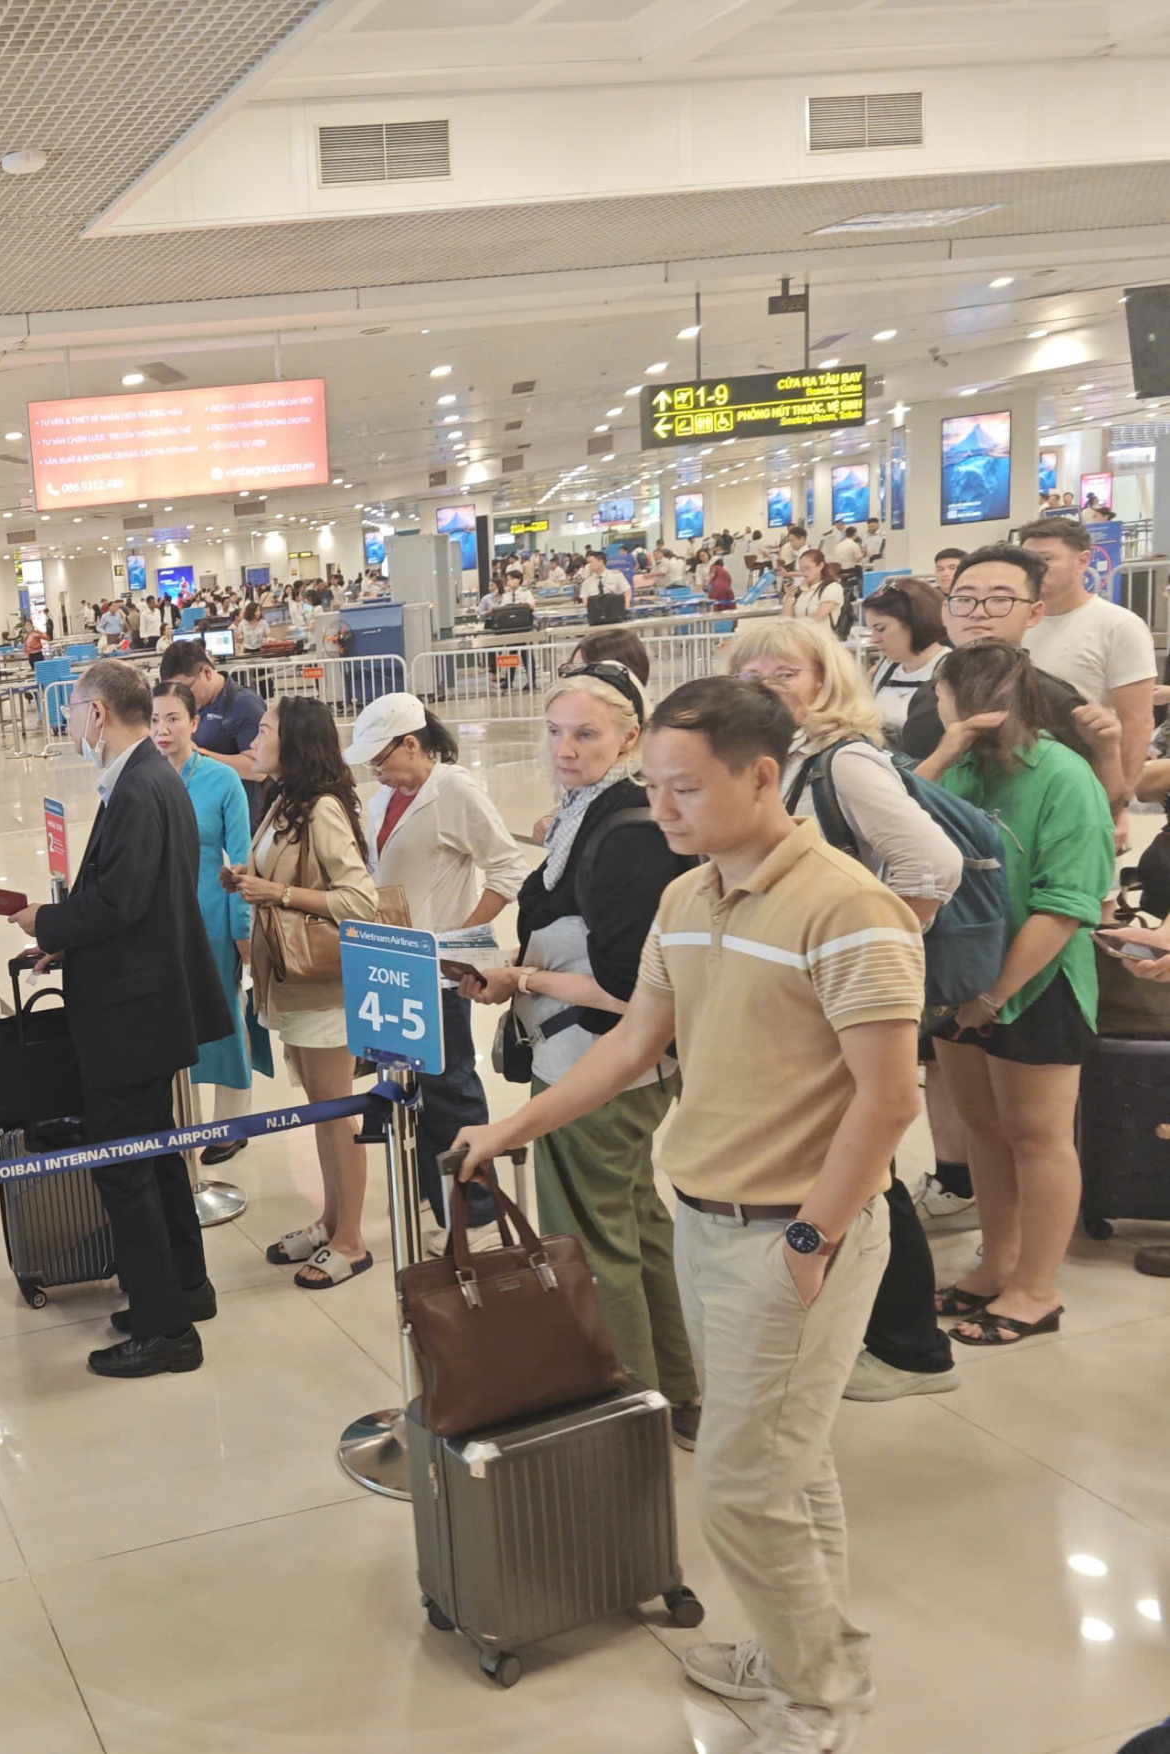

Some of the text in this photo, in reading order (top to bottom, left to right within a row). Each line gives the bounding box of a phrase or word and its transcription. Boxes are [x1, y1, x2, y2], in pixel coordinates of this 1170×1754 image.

[802, 376, 818, 388] RA
[818, 372, 840, 385] TÀU
[841, 372, 862, 384] BAY
[806, 384, 862, 396] Boarding Gates
[696, 384, 730, 407] 1-9
[737, 408, 770, 422] PHÒNG
[772, 405, 791, 418] HÚT
[827, 400, 840, 414] VỆ
[841, 398, 862, 410] SINH
[780, 411, 862, 426] Smoking Room, Toilets
[359, 930, 420, 949] Vietnam Airlines
[368, 966, 410, 988] ZONE
[358, 991, 426, 1040] 4-5
[45, 1138, 164, 1170] INTERNATIONAL
[167, 1125, 230, 1147] AIRPORT
[266, 1112, 301, 1129] N.I.A
